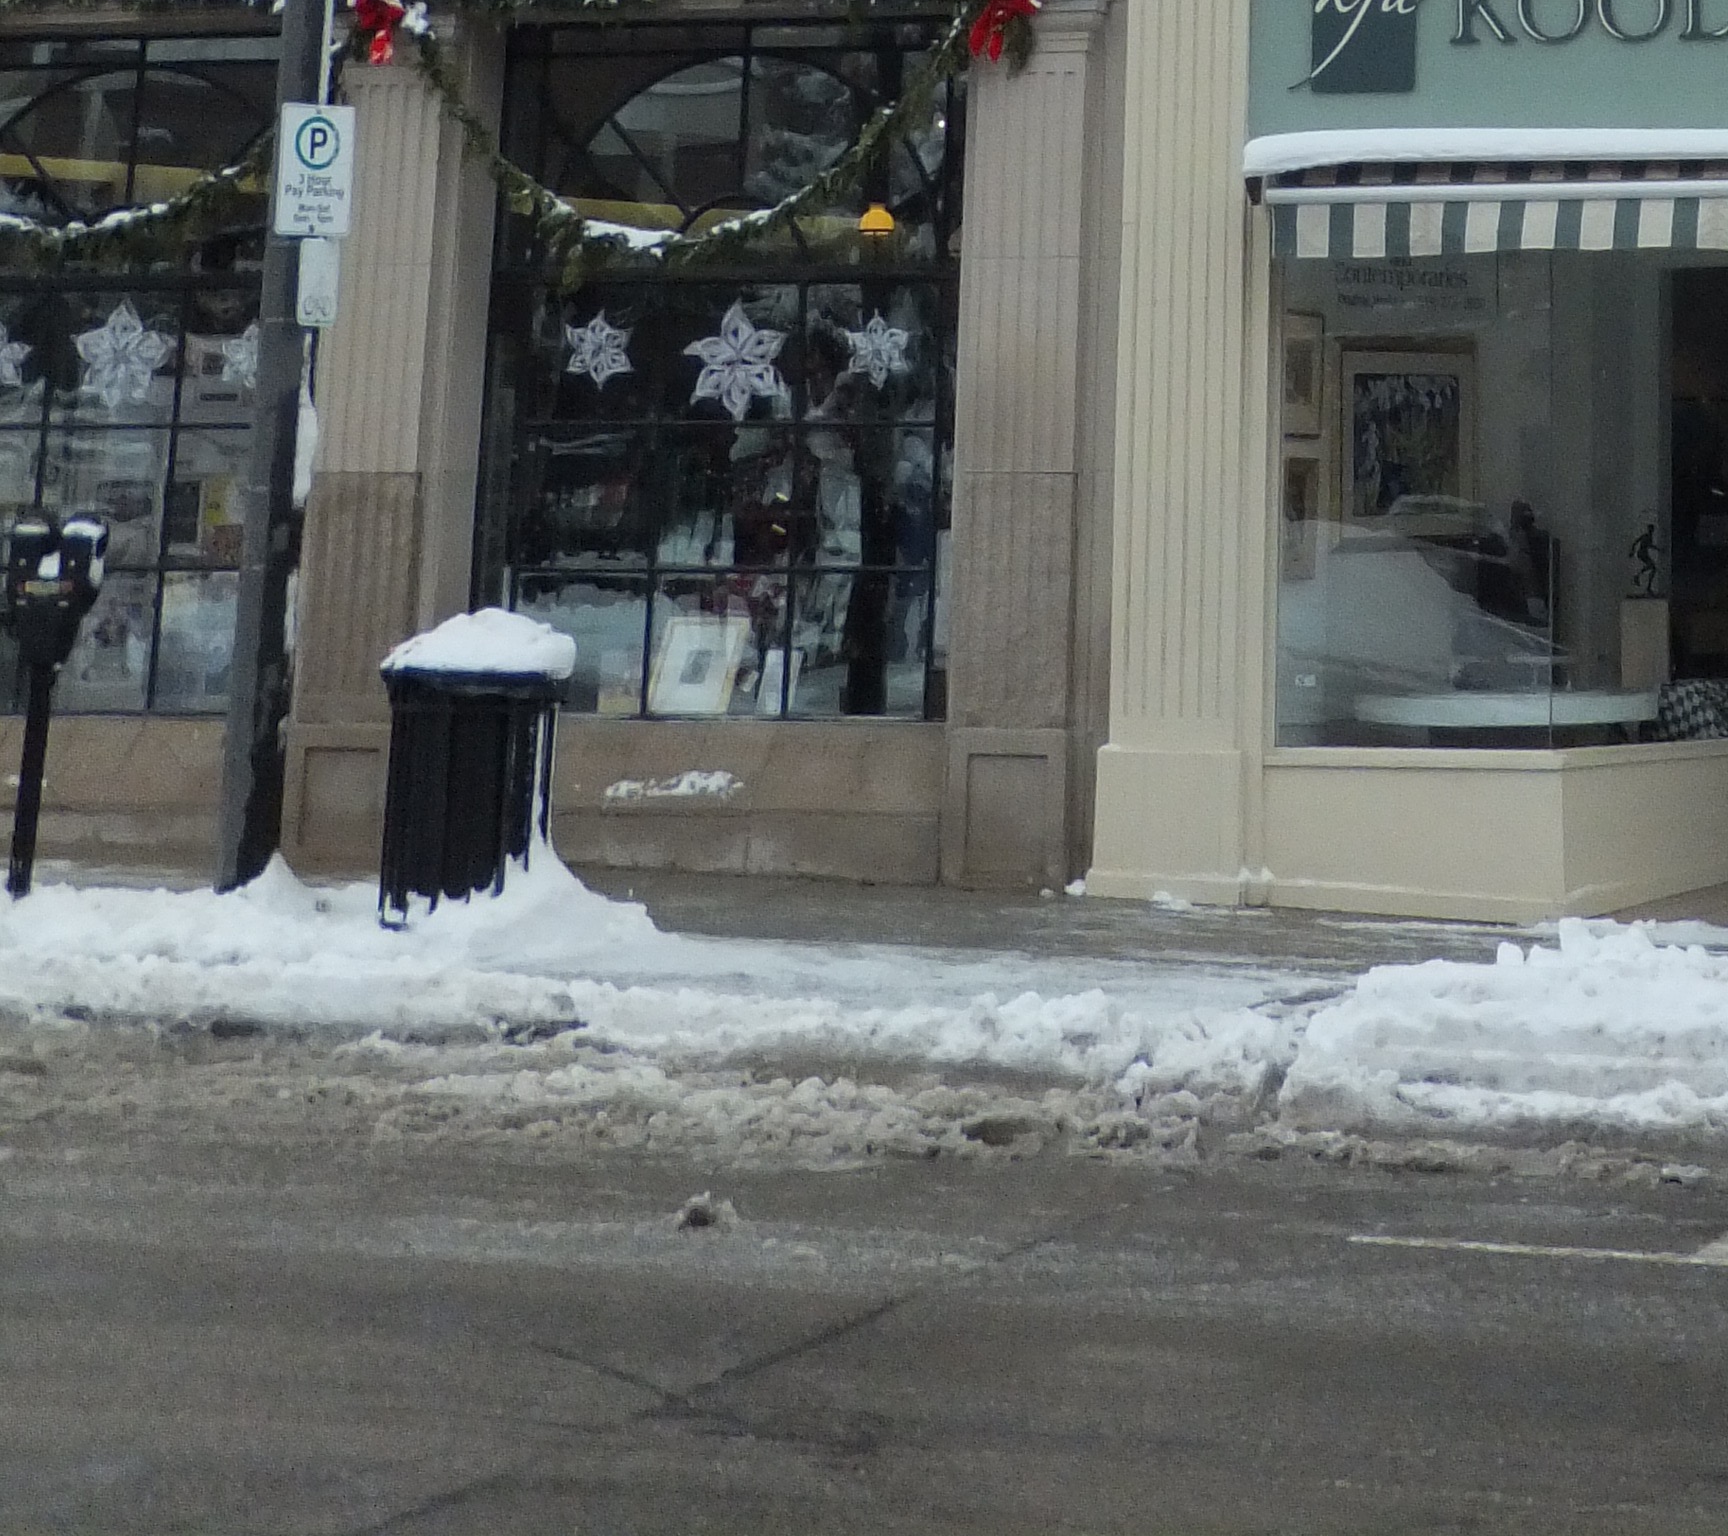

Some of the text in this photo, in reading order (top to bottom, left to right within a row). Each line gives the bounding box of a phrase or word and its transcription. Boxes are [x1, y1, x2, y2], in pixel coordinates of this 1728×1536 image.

[309, 127, 328, 159] P
[284, 184, 345, 200] Pay Parking
